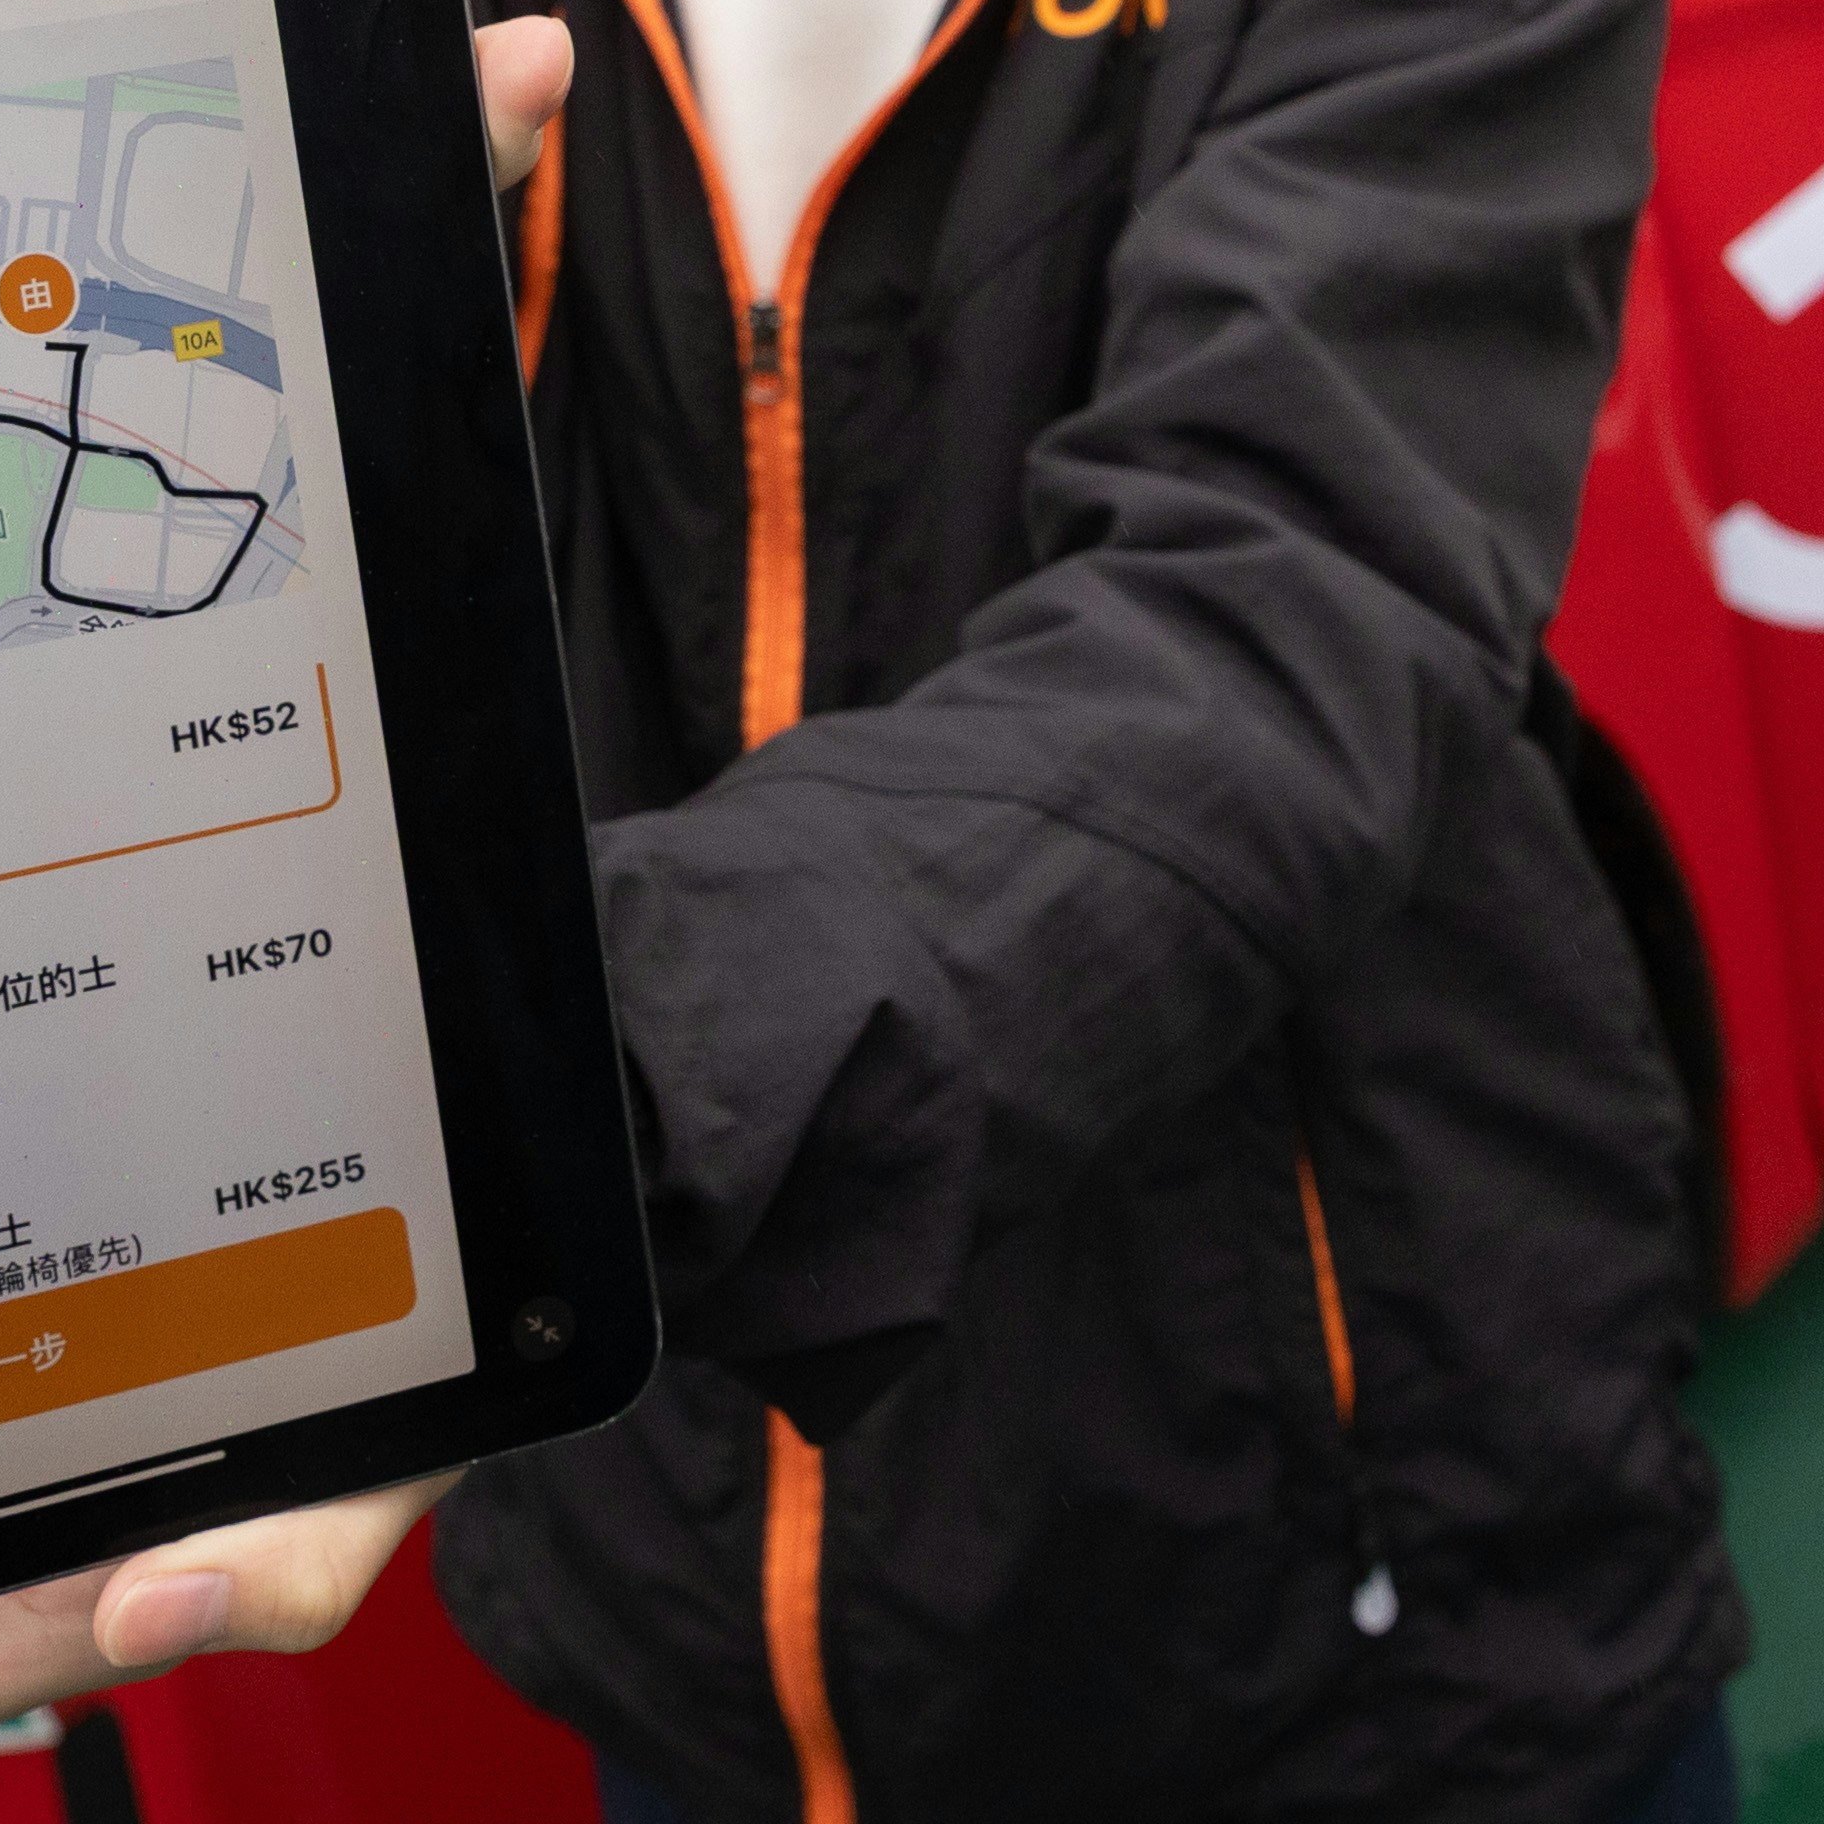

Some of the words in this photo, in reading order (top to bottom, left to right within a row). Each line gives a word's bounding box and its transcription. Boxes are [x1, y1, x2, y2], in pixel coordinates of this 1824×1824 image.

[19, 278, 53, 313] 由
[179, 328, 219, 353] 10A
[170, 700, 300, 753] HK$52
[206, 928, 333, 982] HK$70
[214, 1152, 367, 1216] HK$255
